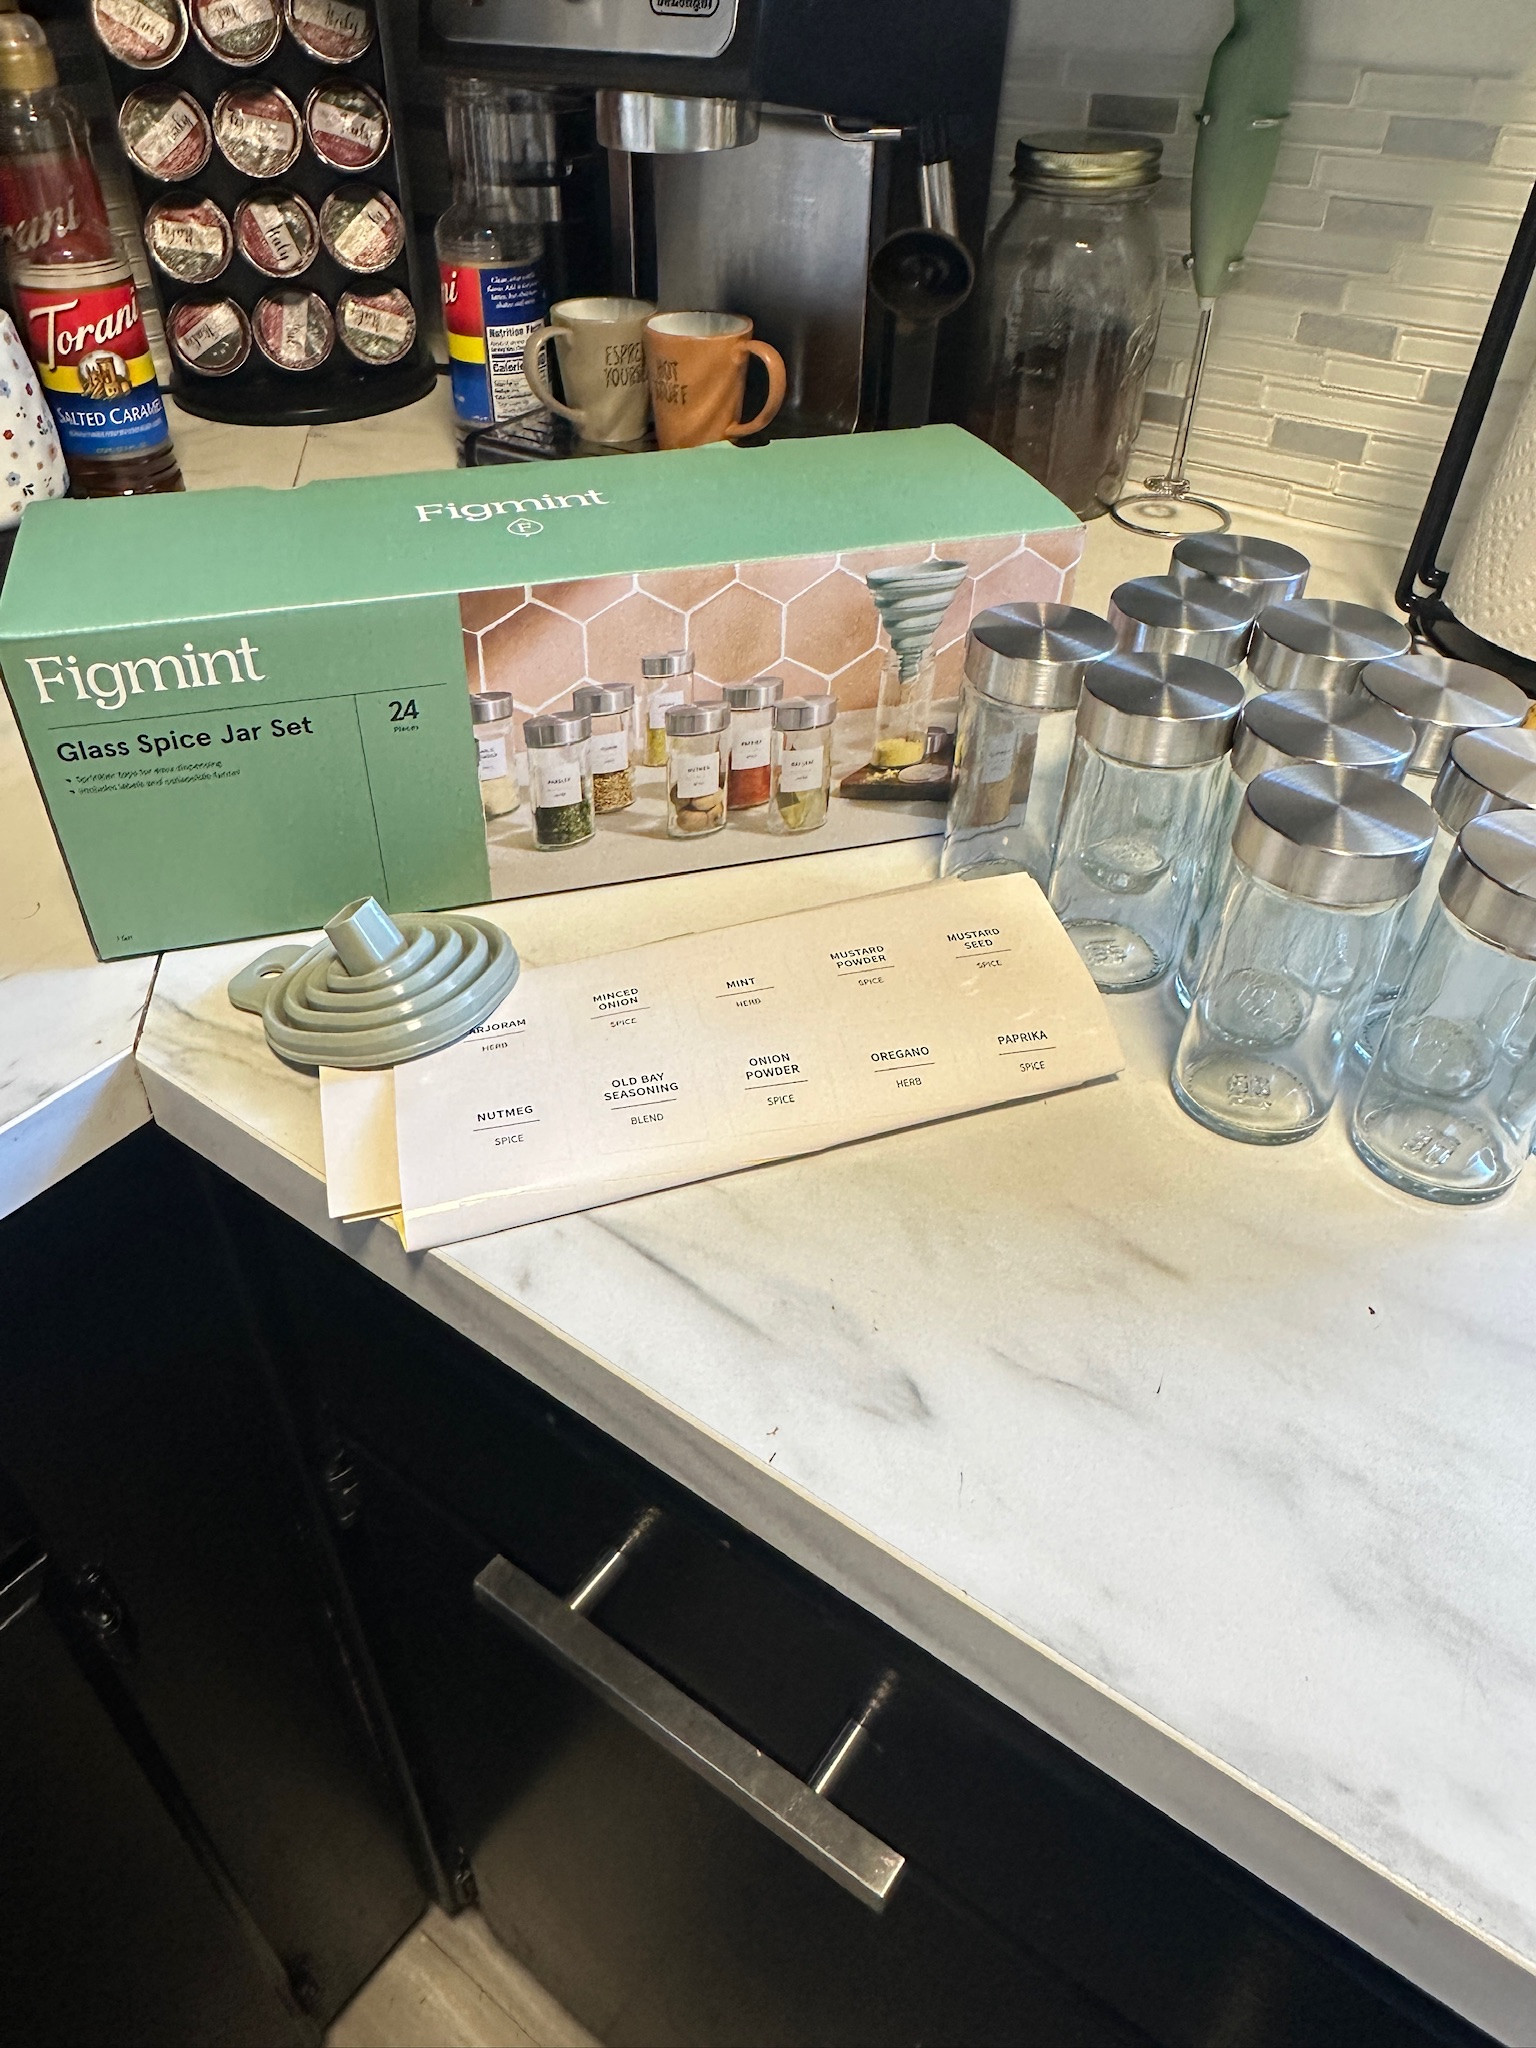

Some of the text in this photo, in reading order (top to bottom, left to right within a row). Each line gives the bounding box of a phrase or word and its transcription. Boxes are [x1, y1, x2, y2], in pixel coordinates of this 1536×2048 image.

[29, 285, 139, 371] Torani
[57, 407, 105, 426] SALTED
[414, 489, 610, 522] Figmint
[25, 637, 267, 711] Figmint
[389, 699, 420, 722] 24
[57, 716, 314, 762] Glass Spice Jar Set
[947, 928, 1000, 942] MUSTARD
[964, 939, 993, 950] SEED
[830, 946, 885, 960] MUSTARD
[836, 955, 887, 969] POWDER
[976, 960, 1003, 969] SPICE
[726, 977, 755, 988] MINT
[858, 976, 885, 986] SPICE
[592, 988, 639, 1003] MINCED
[598, 996, 638, 1011] ONION
[468, 1018, 527, 1035] ARJORAM
[610, 1017, 637, 1028] SPICE
[997, 1030, 1048, 1045] PAPRIKA
[749, 1053, 791, 1067] ONION
[870, 1046, 930, 1062] OREGANO
[745, 1064, 800, 1080] POWDER
[1019, 1061, 1045, 1073] SPICE
[611, 1072, 665, 1088] OLD BAY
[896, 1077, 922, 1088] HERB
[604, 1082, 679, 1101] SEASONING
[767, 1094, 795, 1106] SPICE
[477, 1105, 534, 1122] NUTMEG
[631, 1113, 664, 1125] BLEND
[494, 1134, 524, 1146] SPICE
